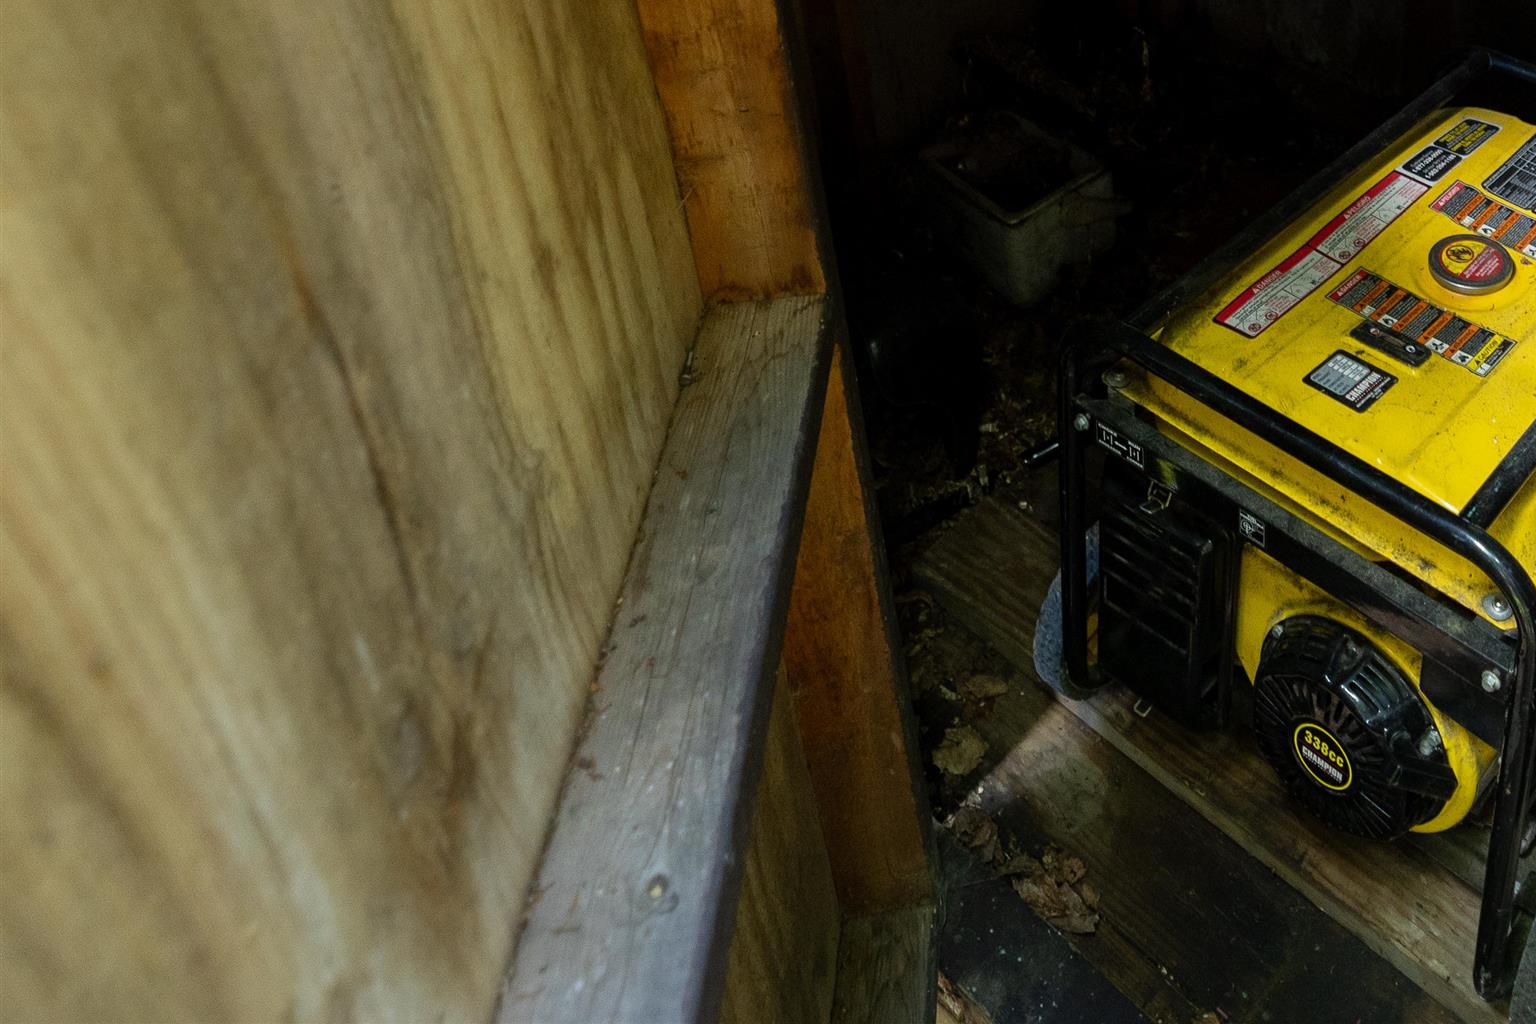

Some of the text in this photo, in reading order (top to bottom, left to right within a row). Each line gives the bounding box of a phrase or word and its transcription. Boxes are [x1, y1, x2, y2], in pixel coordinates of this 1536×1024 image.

[1349, 196, 1371, 217] PELIGRO
[1258, 270, 1282, 292] DANGER
[1340, 274, 1362, 295] DANGER
[1478, 339, 1499, 360] CAUTION
[1345, 371, 1381, 402] CHAMPION
[1304, 729, 1344, 768] 338cc
[1302, 744, 1343, 784] CHAMPION
